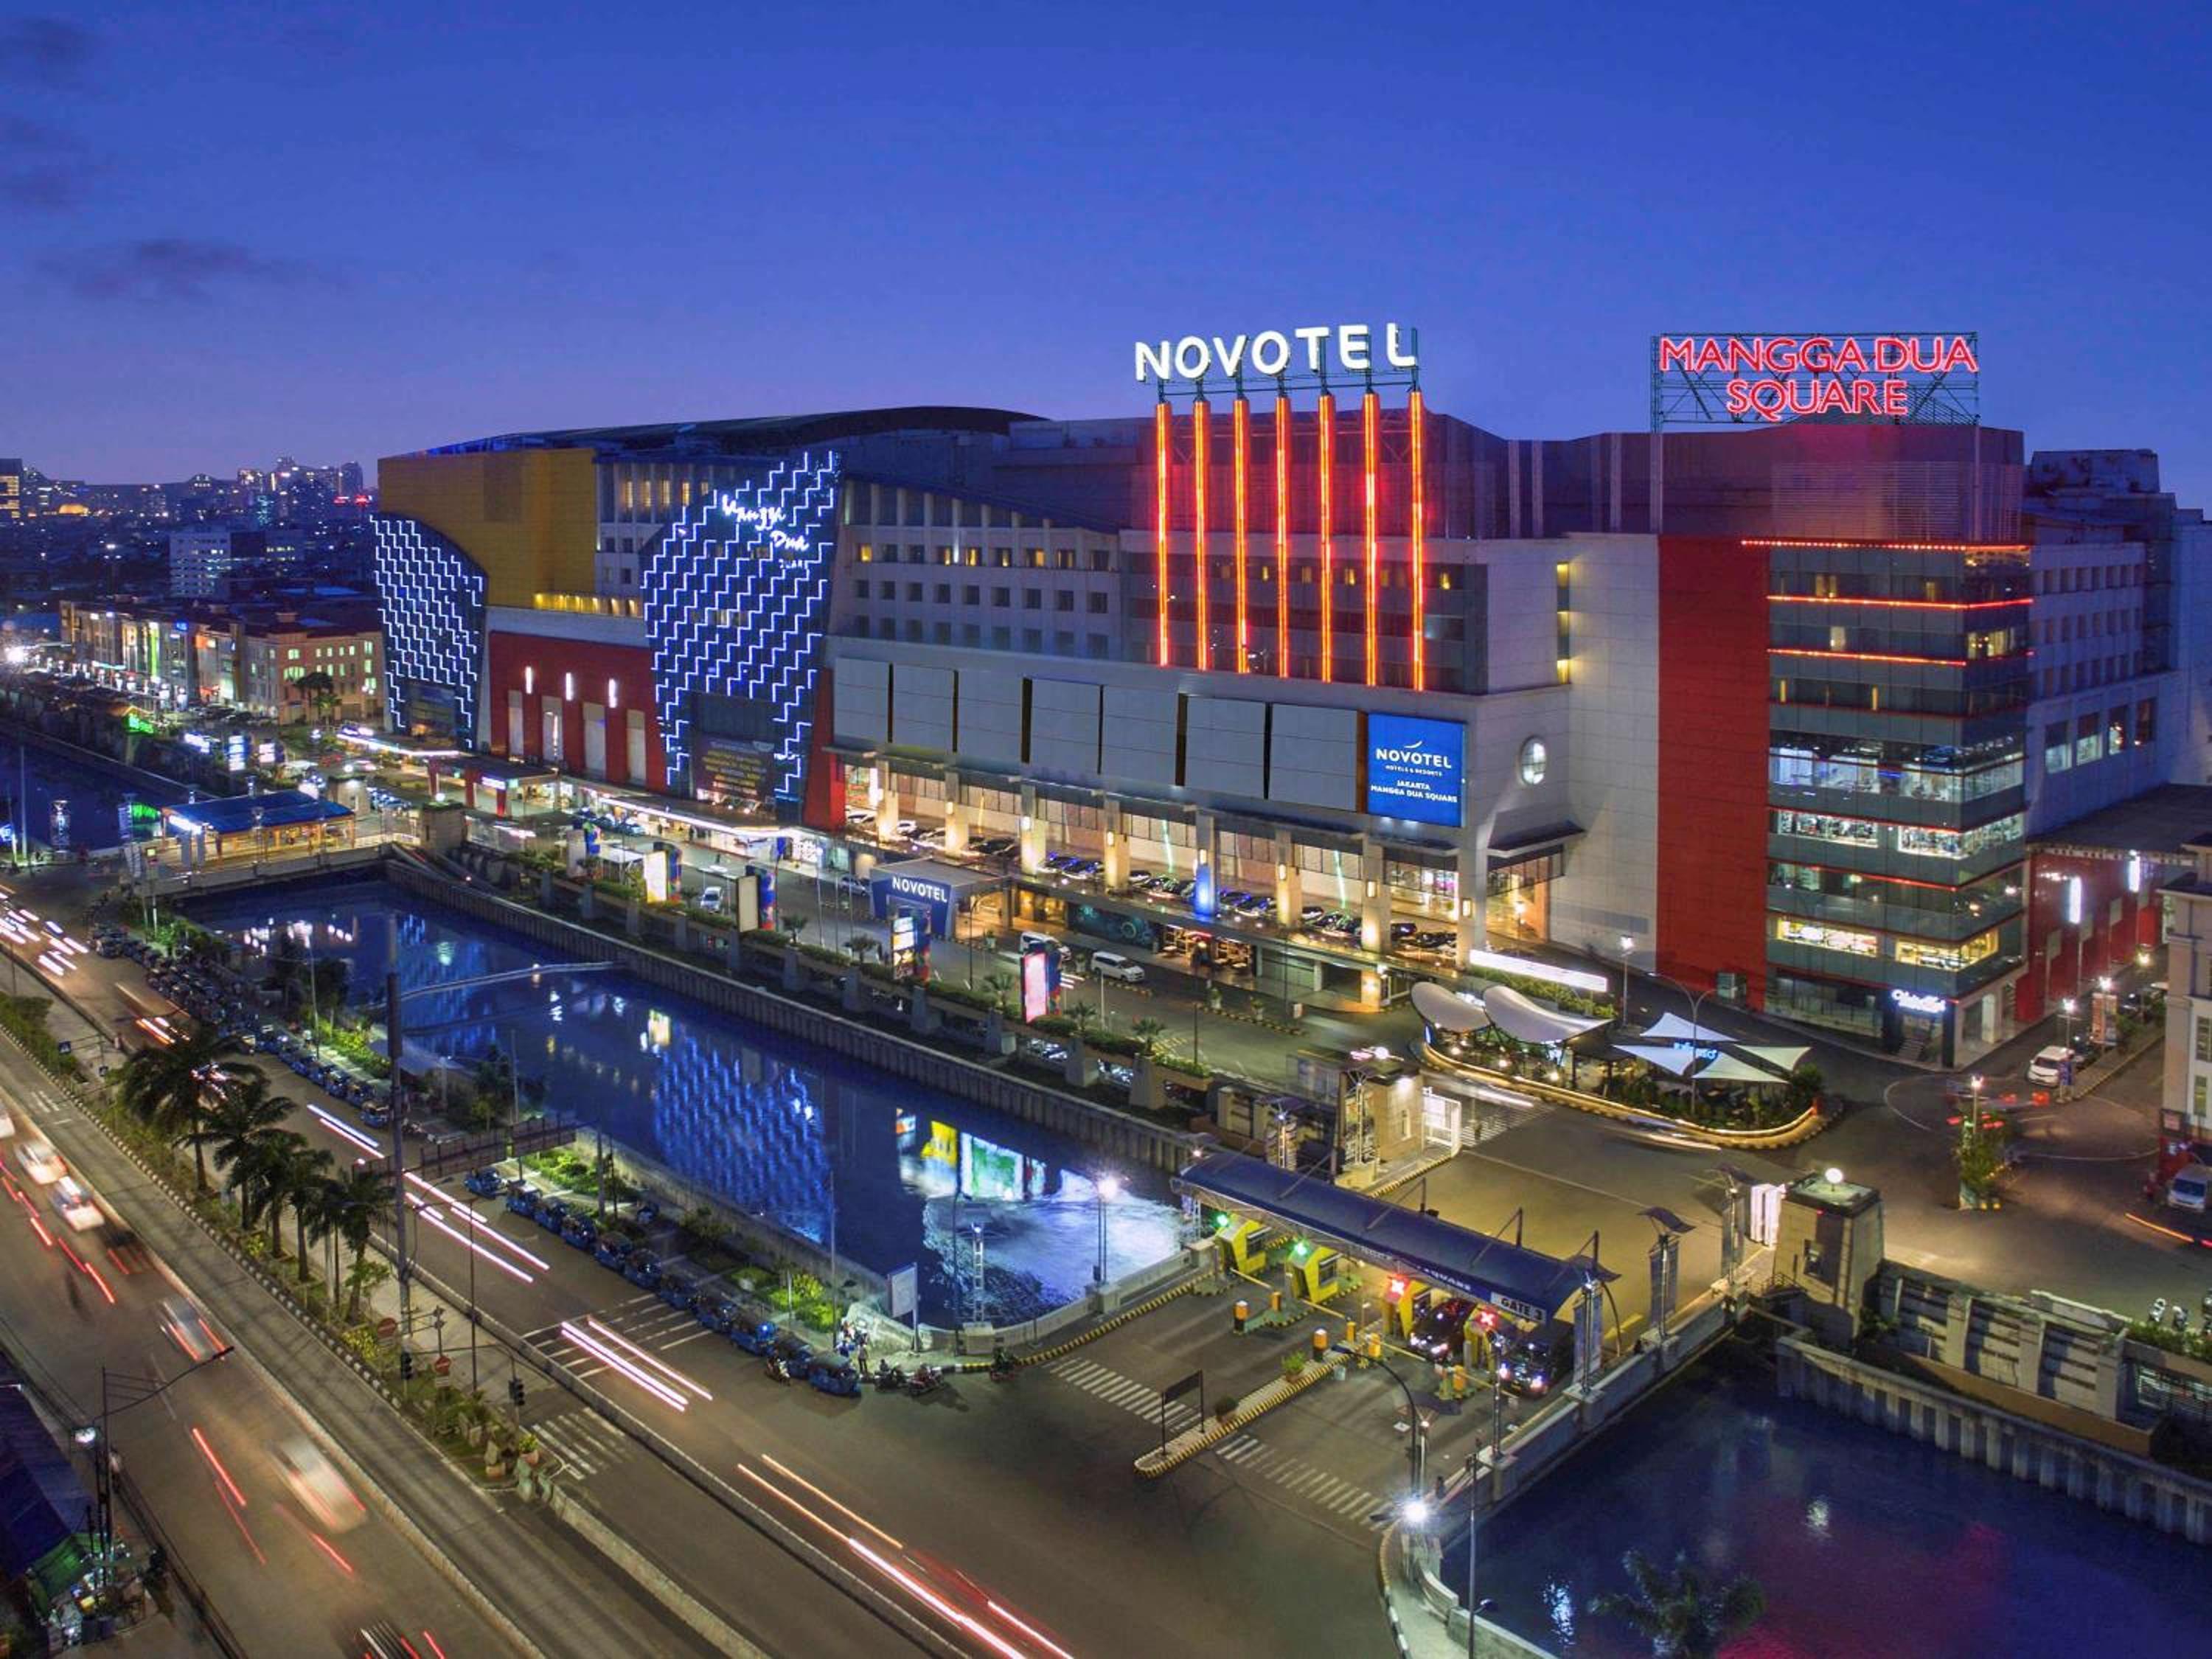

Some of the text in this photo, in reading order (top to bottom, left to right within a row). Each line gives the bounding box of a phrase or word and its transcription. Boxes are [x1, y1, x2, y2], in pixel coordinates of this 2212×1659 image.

[1135, 322, 1416, 382] NOVOTEL
[1660, 335, 1978, 373] MANGGA DUA
[1727, 379, 1909, 422] SQUARE
[1376, 748, 1452, 769] NOVOTEL
[1371, 784, 1458, 803] MANGGA DUA SQUARE
[1397, 779, 1430, 790] JAKARTA
[892, 876, 947, 903] NOVOTEL
[1500, 1297, 1531, 1317] GATE
